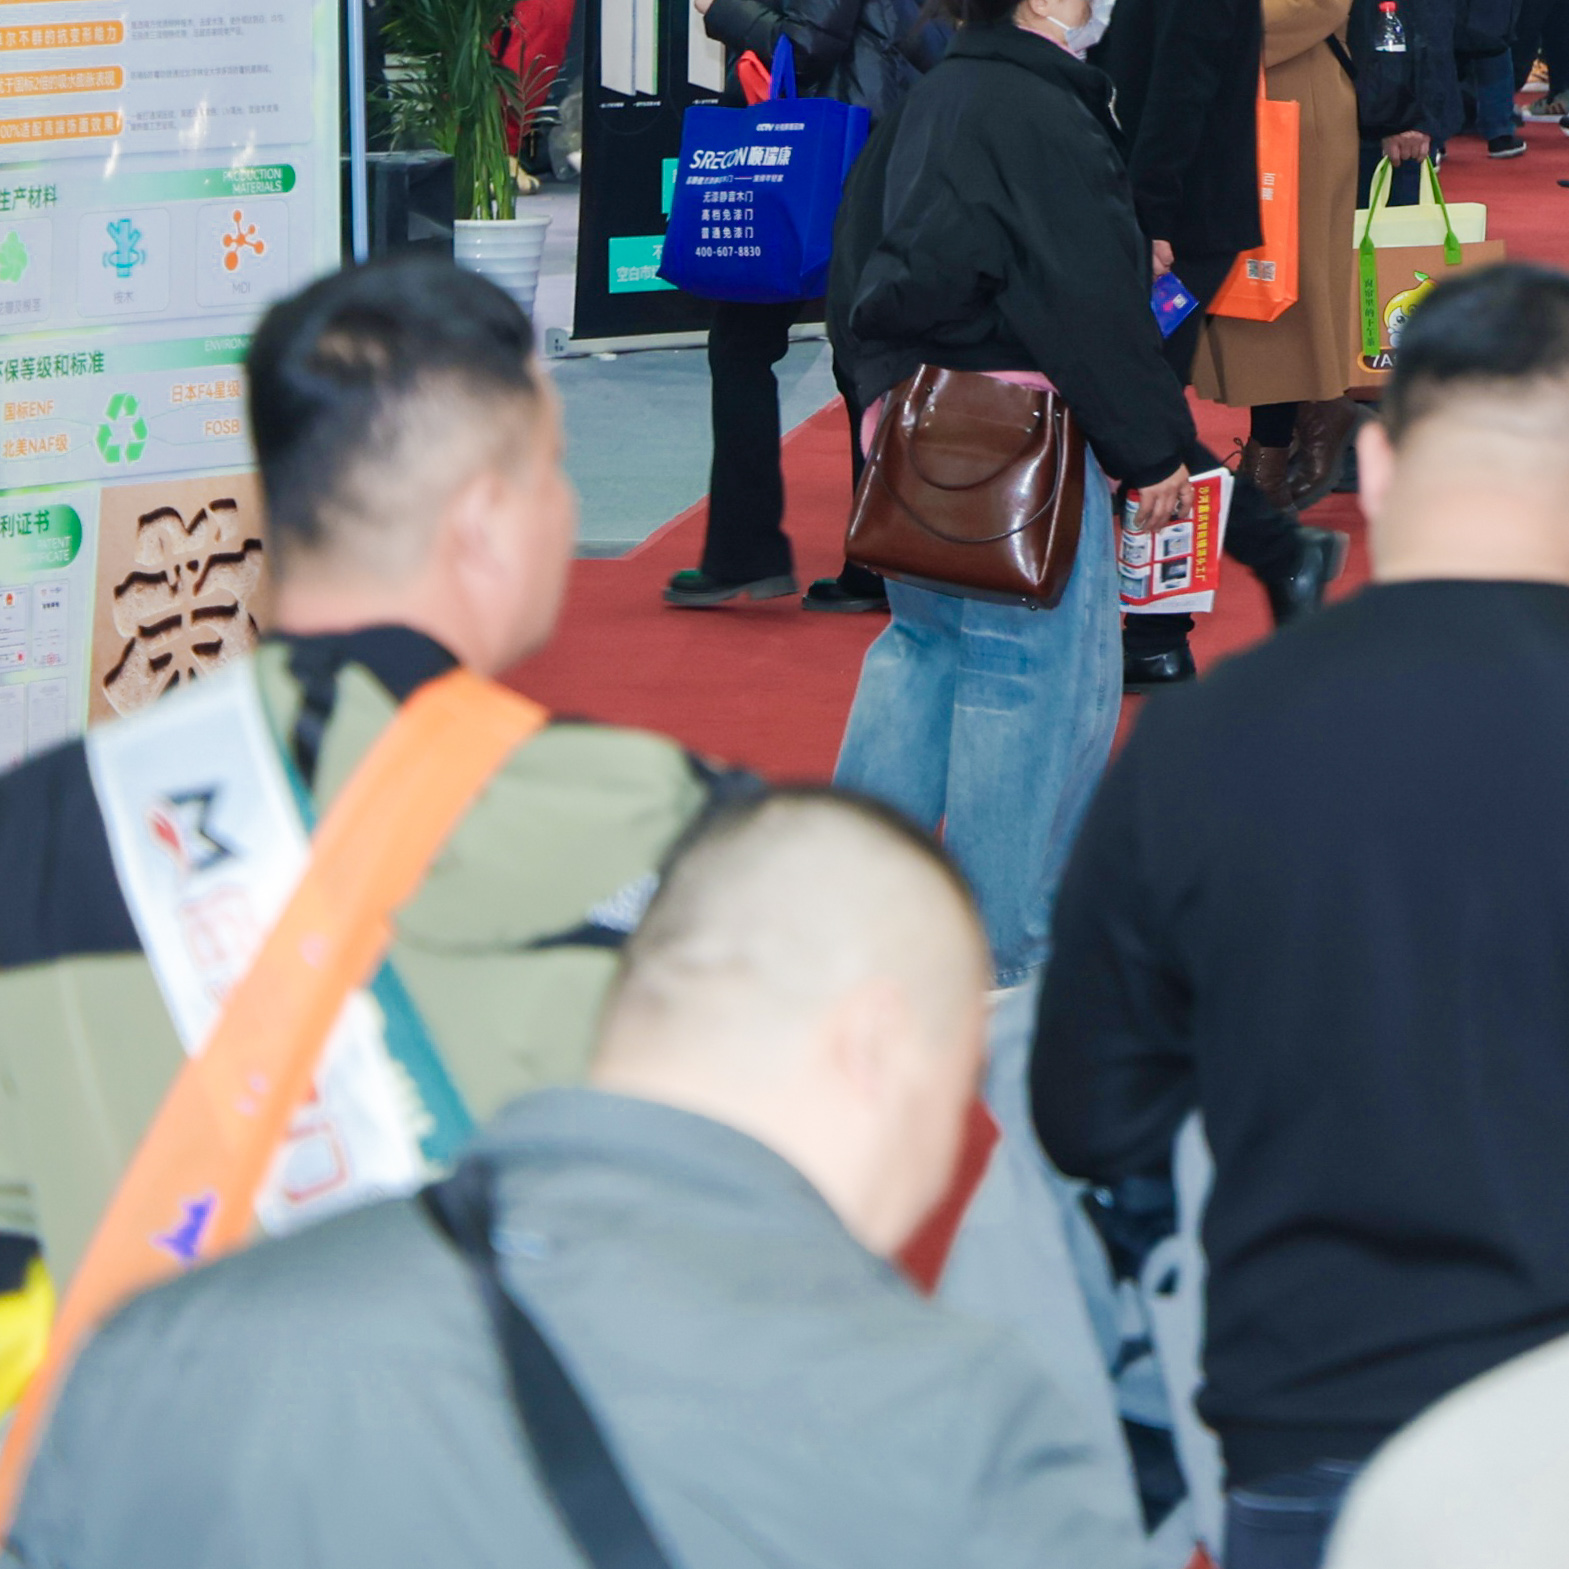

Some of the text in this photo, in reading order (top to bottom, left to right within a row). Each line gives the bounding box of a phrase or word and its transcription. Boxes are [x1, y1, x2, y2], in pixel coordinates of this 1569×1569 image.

[232, 180, 282, 194] MATERIALS
[0, 185, 57, 211] 生产材料
[695, 246, 761, 257] 400-607-8830
[4, 400, 54, 421] 国标ENF
[3, 434, 69, 458] 北美NAF级
